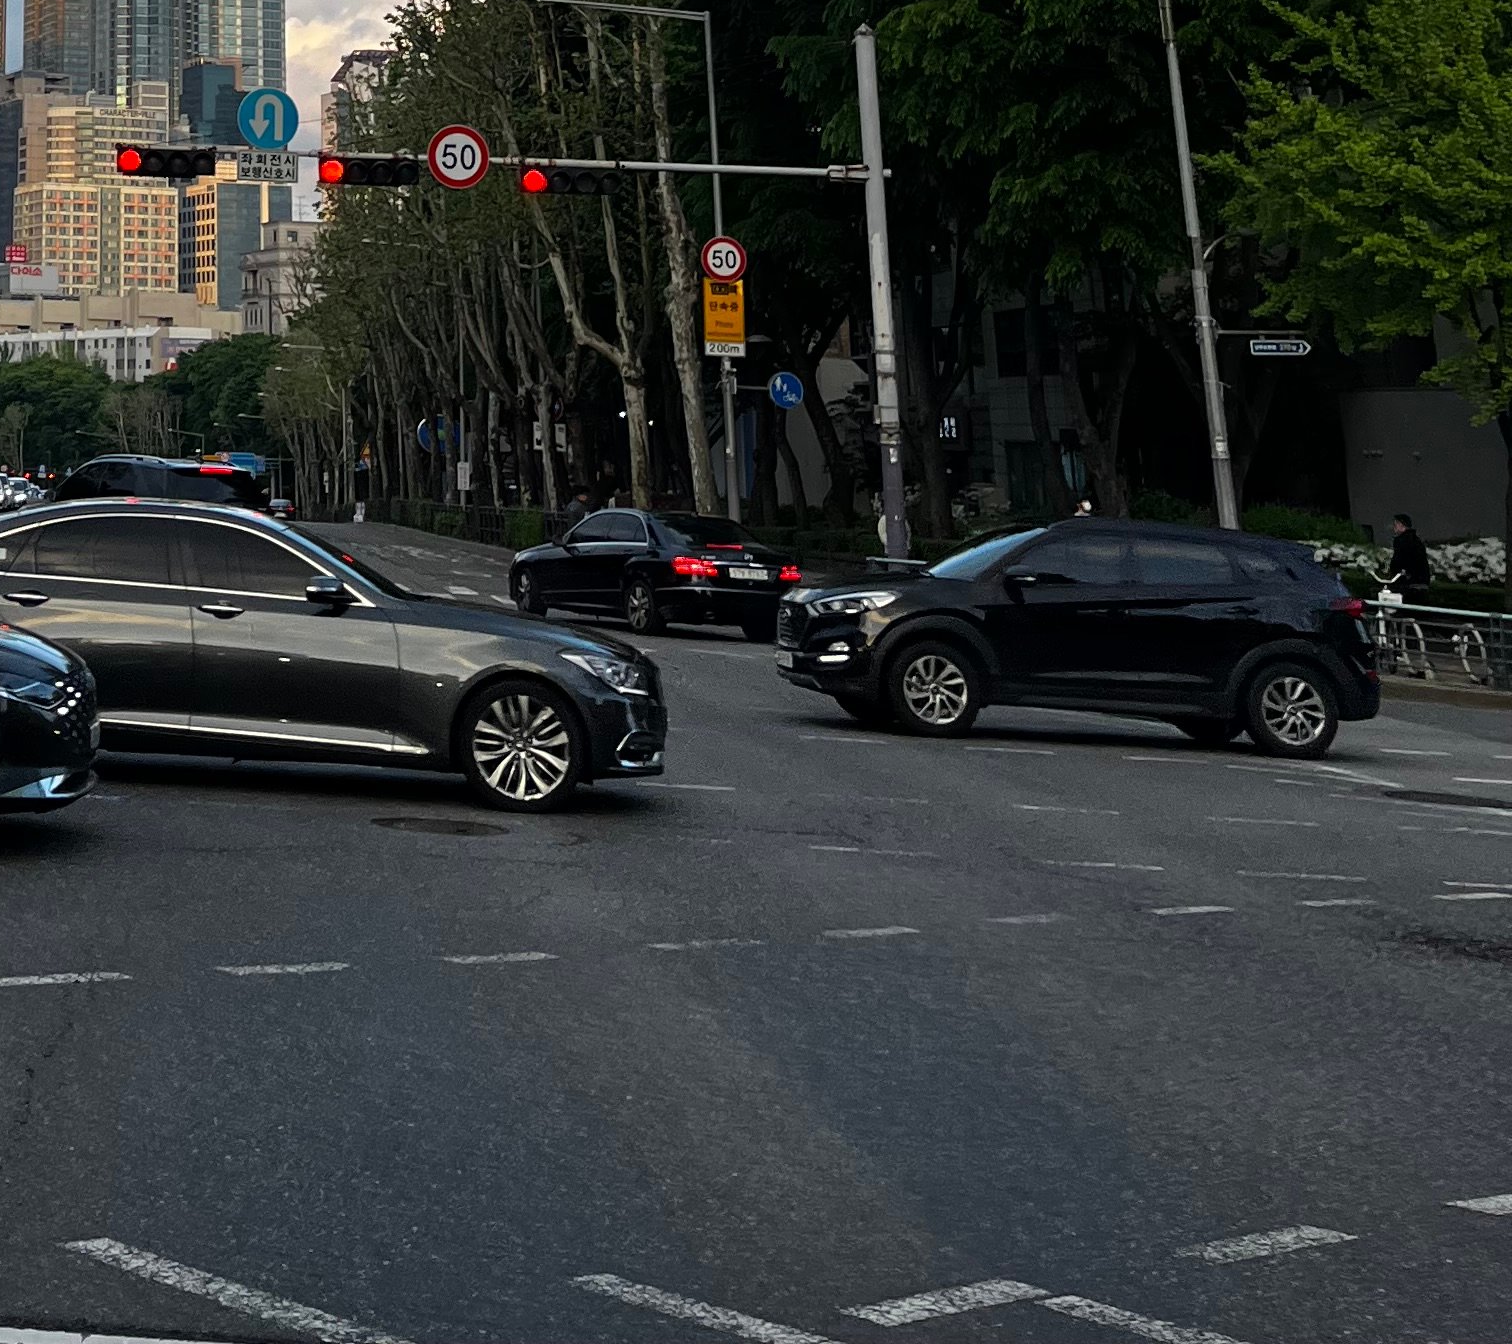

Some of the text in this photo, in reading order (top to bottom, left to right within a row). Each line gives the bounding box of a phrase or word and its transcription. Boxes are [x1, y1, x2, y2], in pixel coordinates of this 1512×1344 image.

[441, 144, 476, 170] 50
[240, 166, 296, 180] 보행신호시
[712, 250, 737, 269] 50
[10, 265, 43, 277] 다이소
[709, 301, 739, 312] 단속중
[709, 343, 740, 354] 200m
